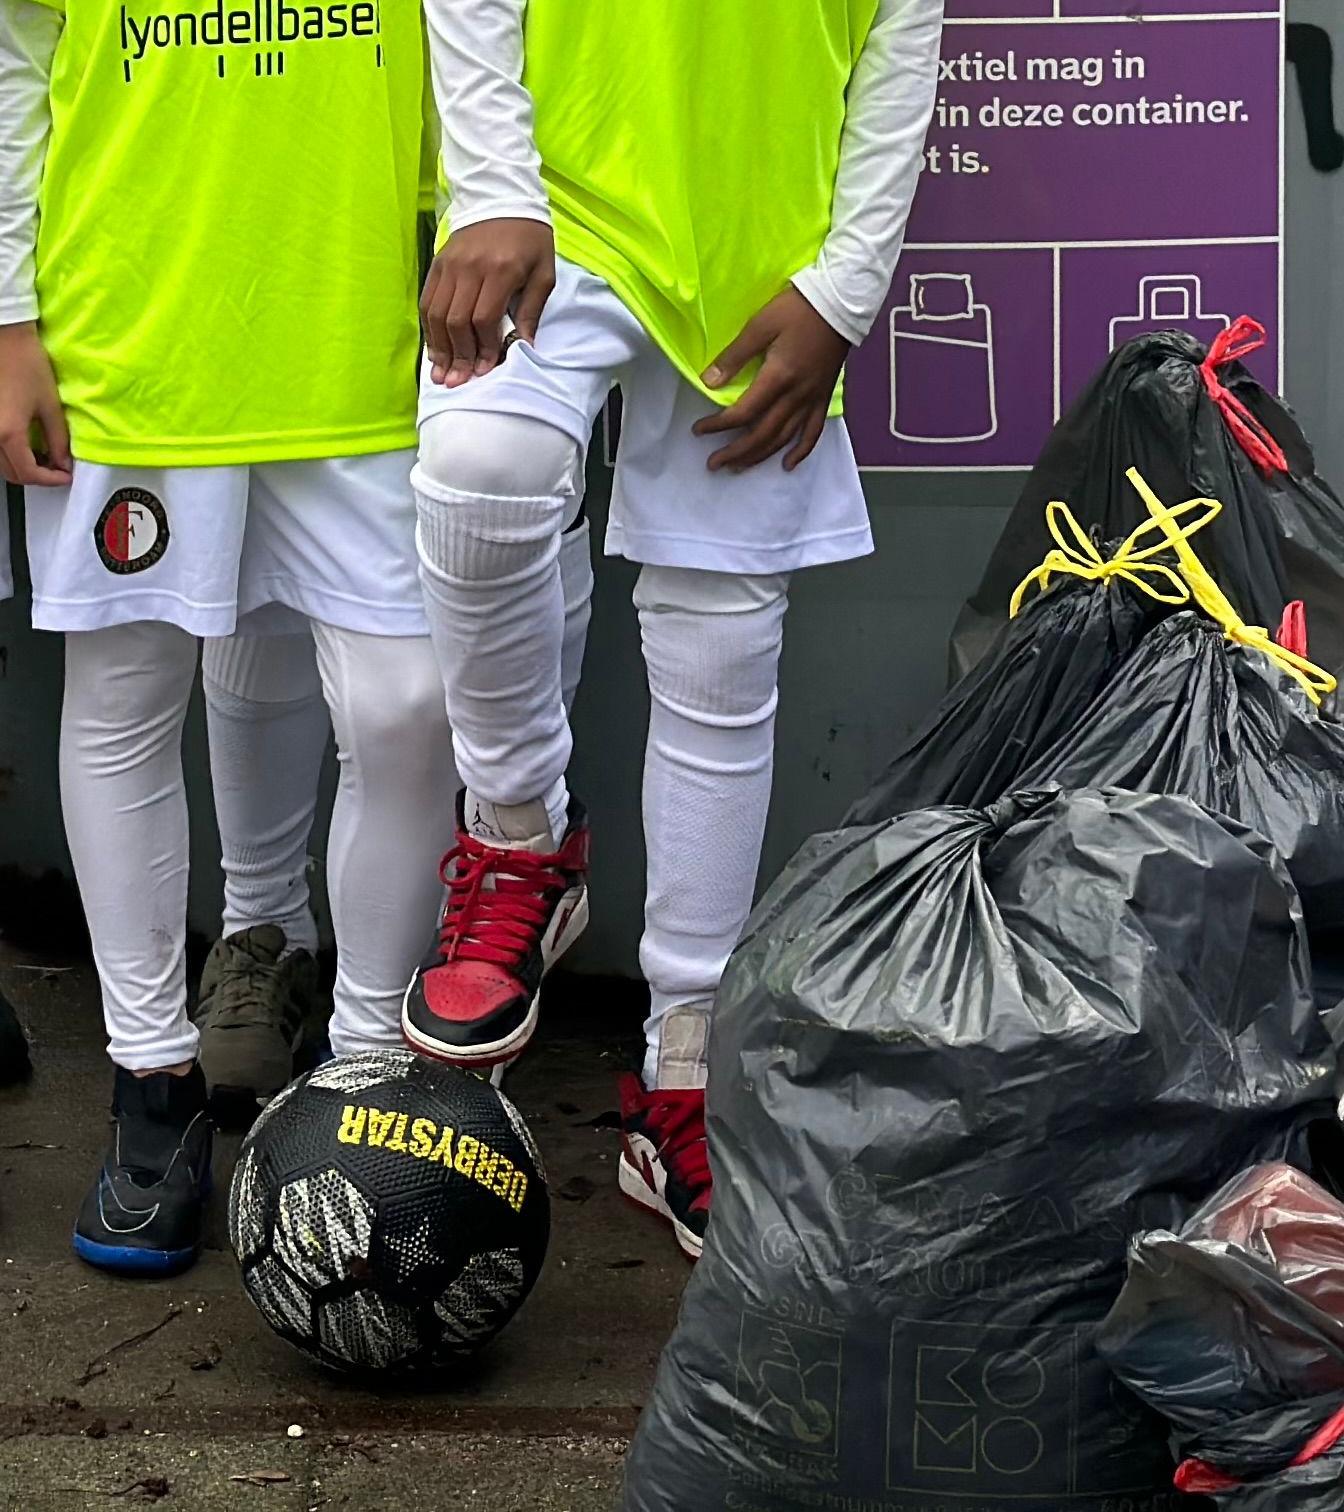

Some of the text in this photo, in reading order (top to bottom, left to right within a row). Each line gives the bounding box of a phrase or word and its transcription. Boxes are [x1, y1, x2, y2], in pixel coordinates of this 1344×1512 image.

[1026, 58, 1104, 87] mag
[1112, 49, 1146, 80] in
[937, 93, 1250, 128] in deze container.
[949, 143, 991, 174] is.
[337, 1105, 529, 1213] DERBYSTAR
